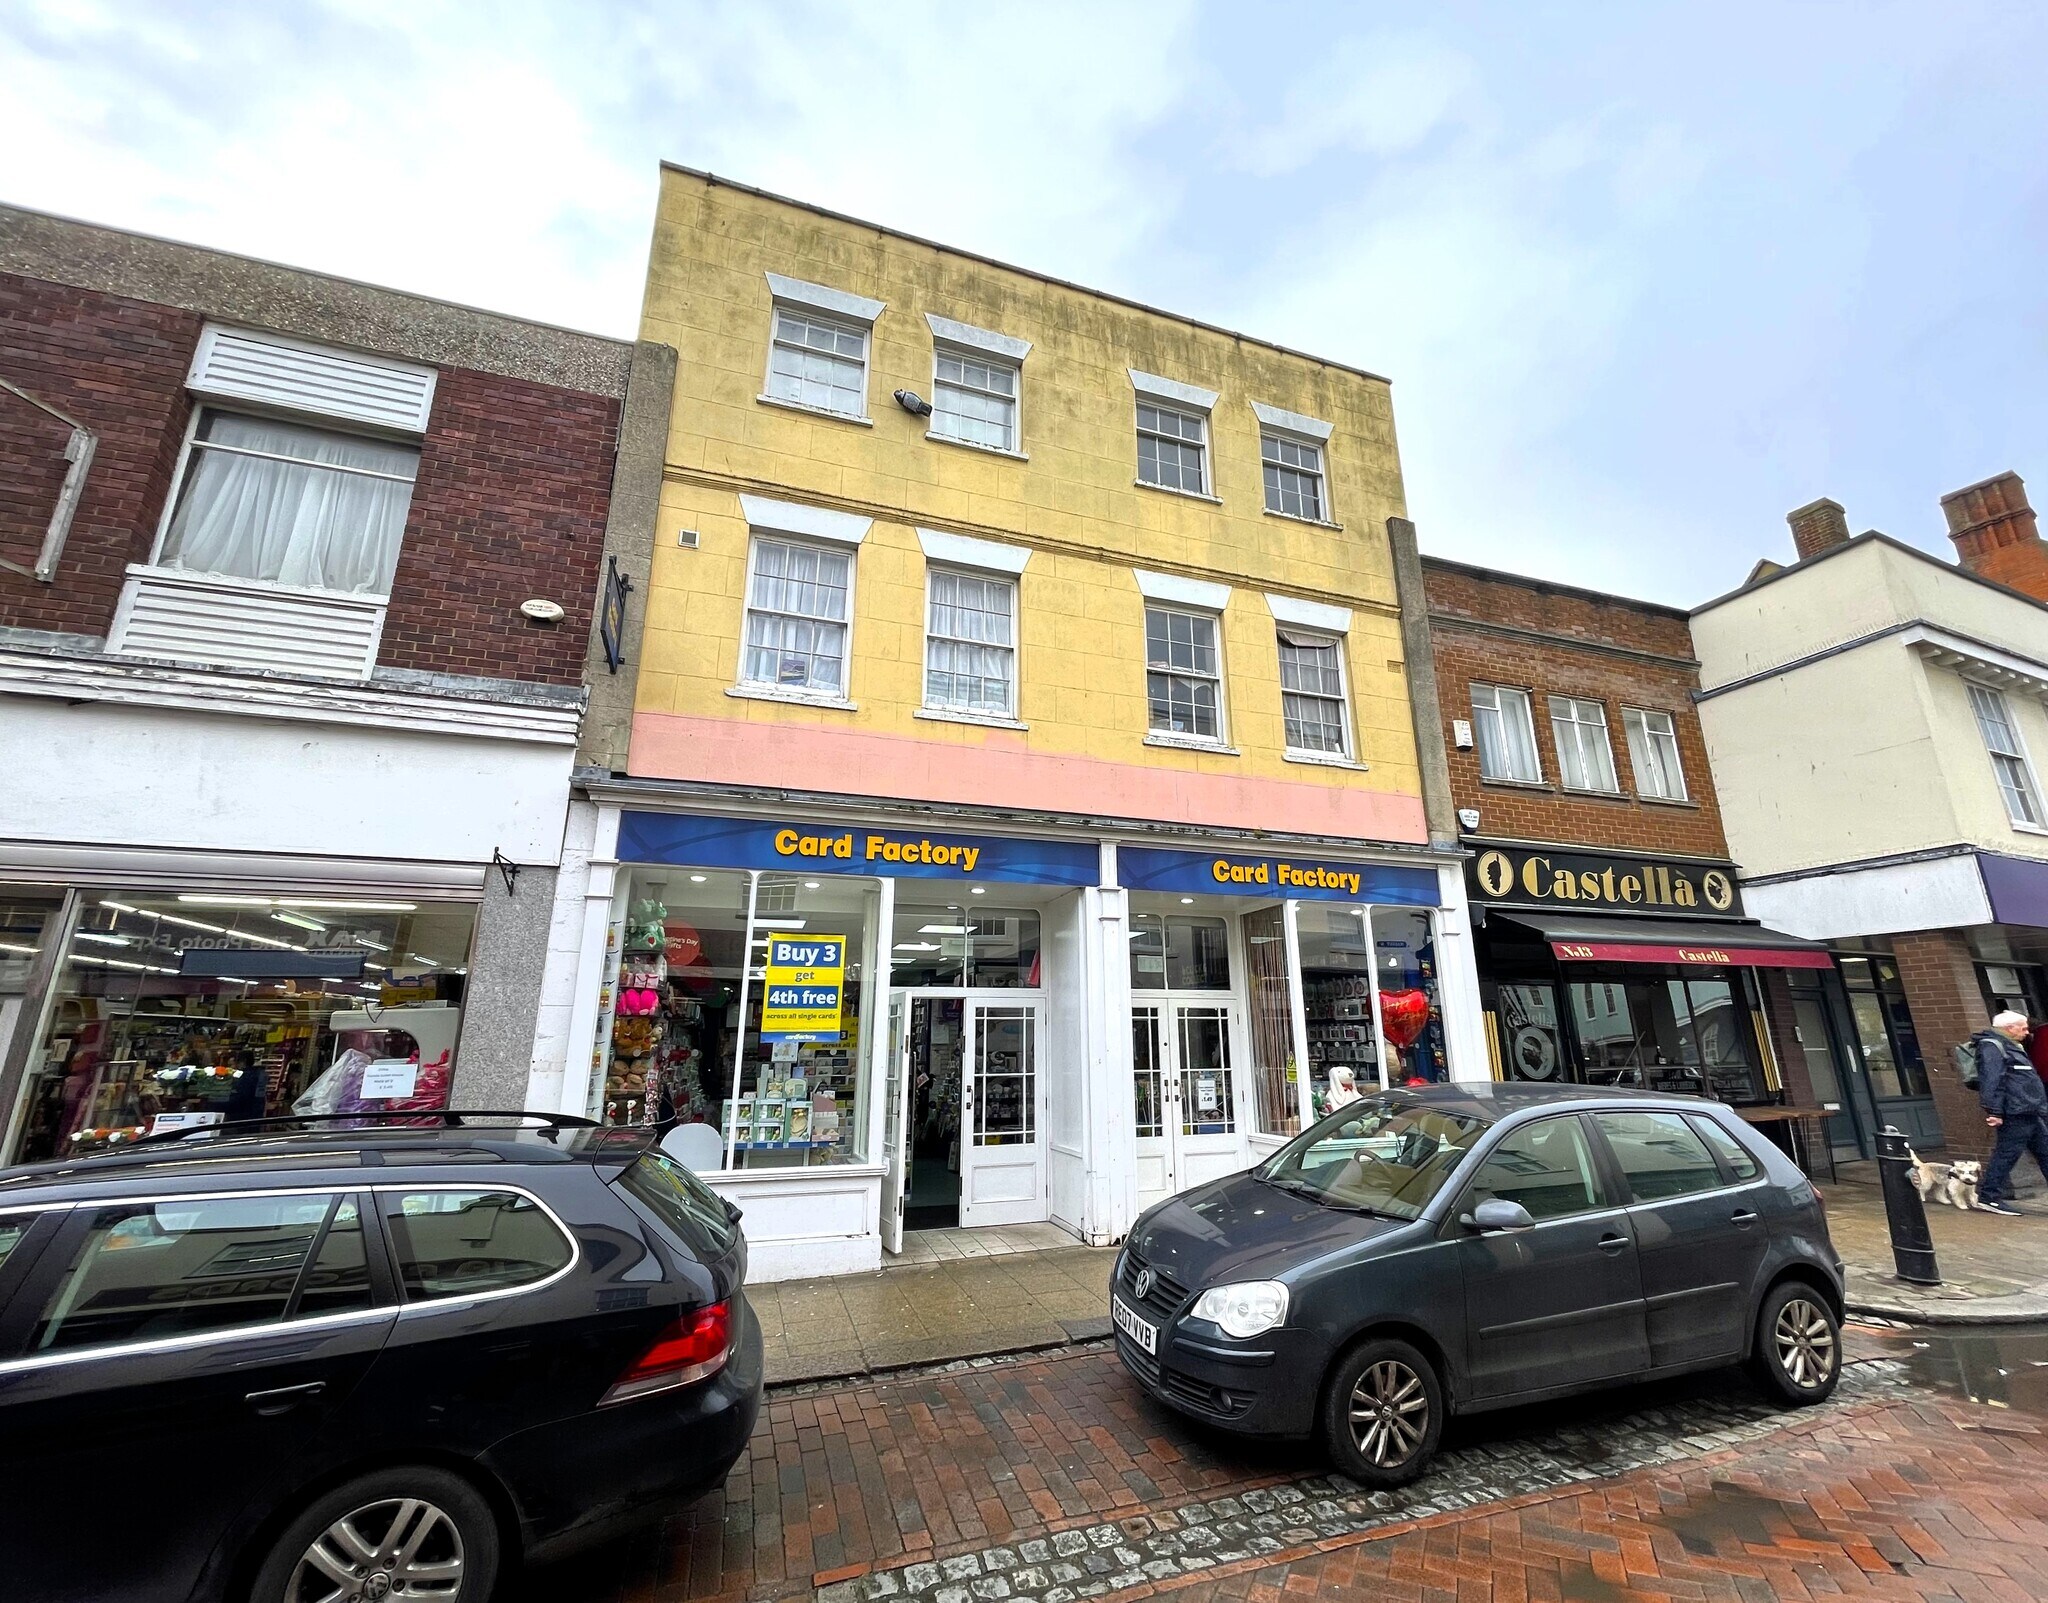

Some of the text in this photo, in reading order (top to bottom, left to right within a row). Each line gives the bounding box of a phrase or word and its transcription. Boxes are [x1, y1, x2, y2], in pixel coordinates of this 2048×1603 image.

[774, 829, 979, 871] Card Factory
[1212, 860, 1361, 894] Card Factory
[1522, 856, 1699, 907] Castellà
[686, 938, 699, 946] Day
[777, 943, 836, 966] Buy 3
[1679, 949, 1730, 963] Castellà
[795, 971, 815, 982] get
[769, 990, 837, 1005] 4th free
